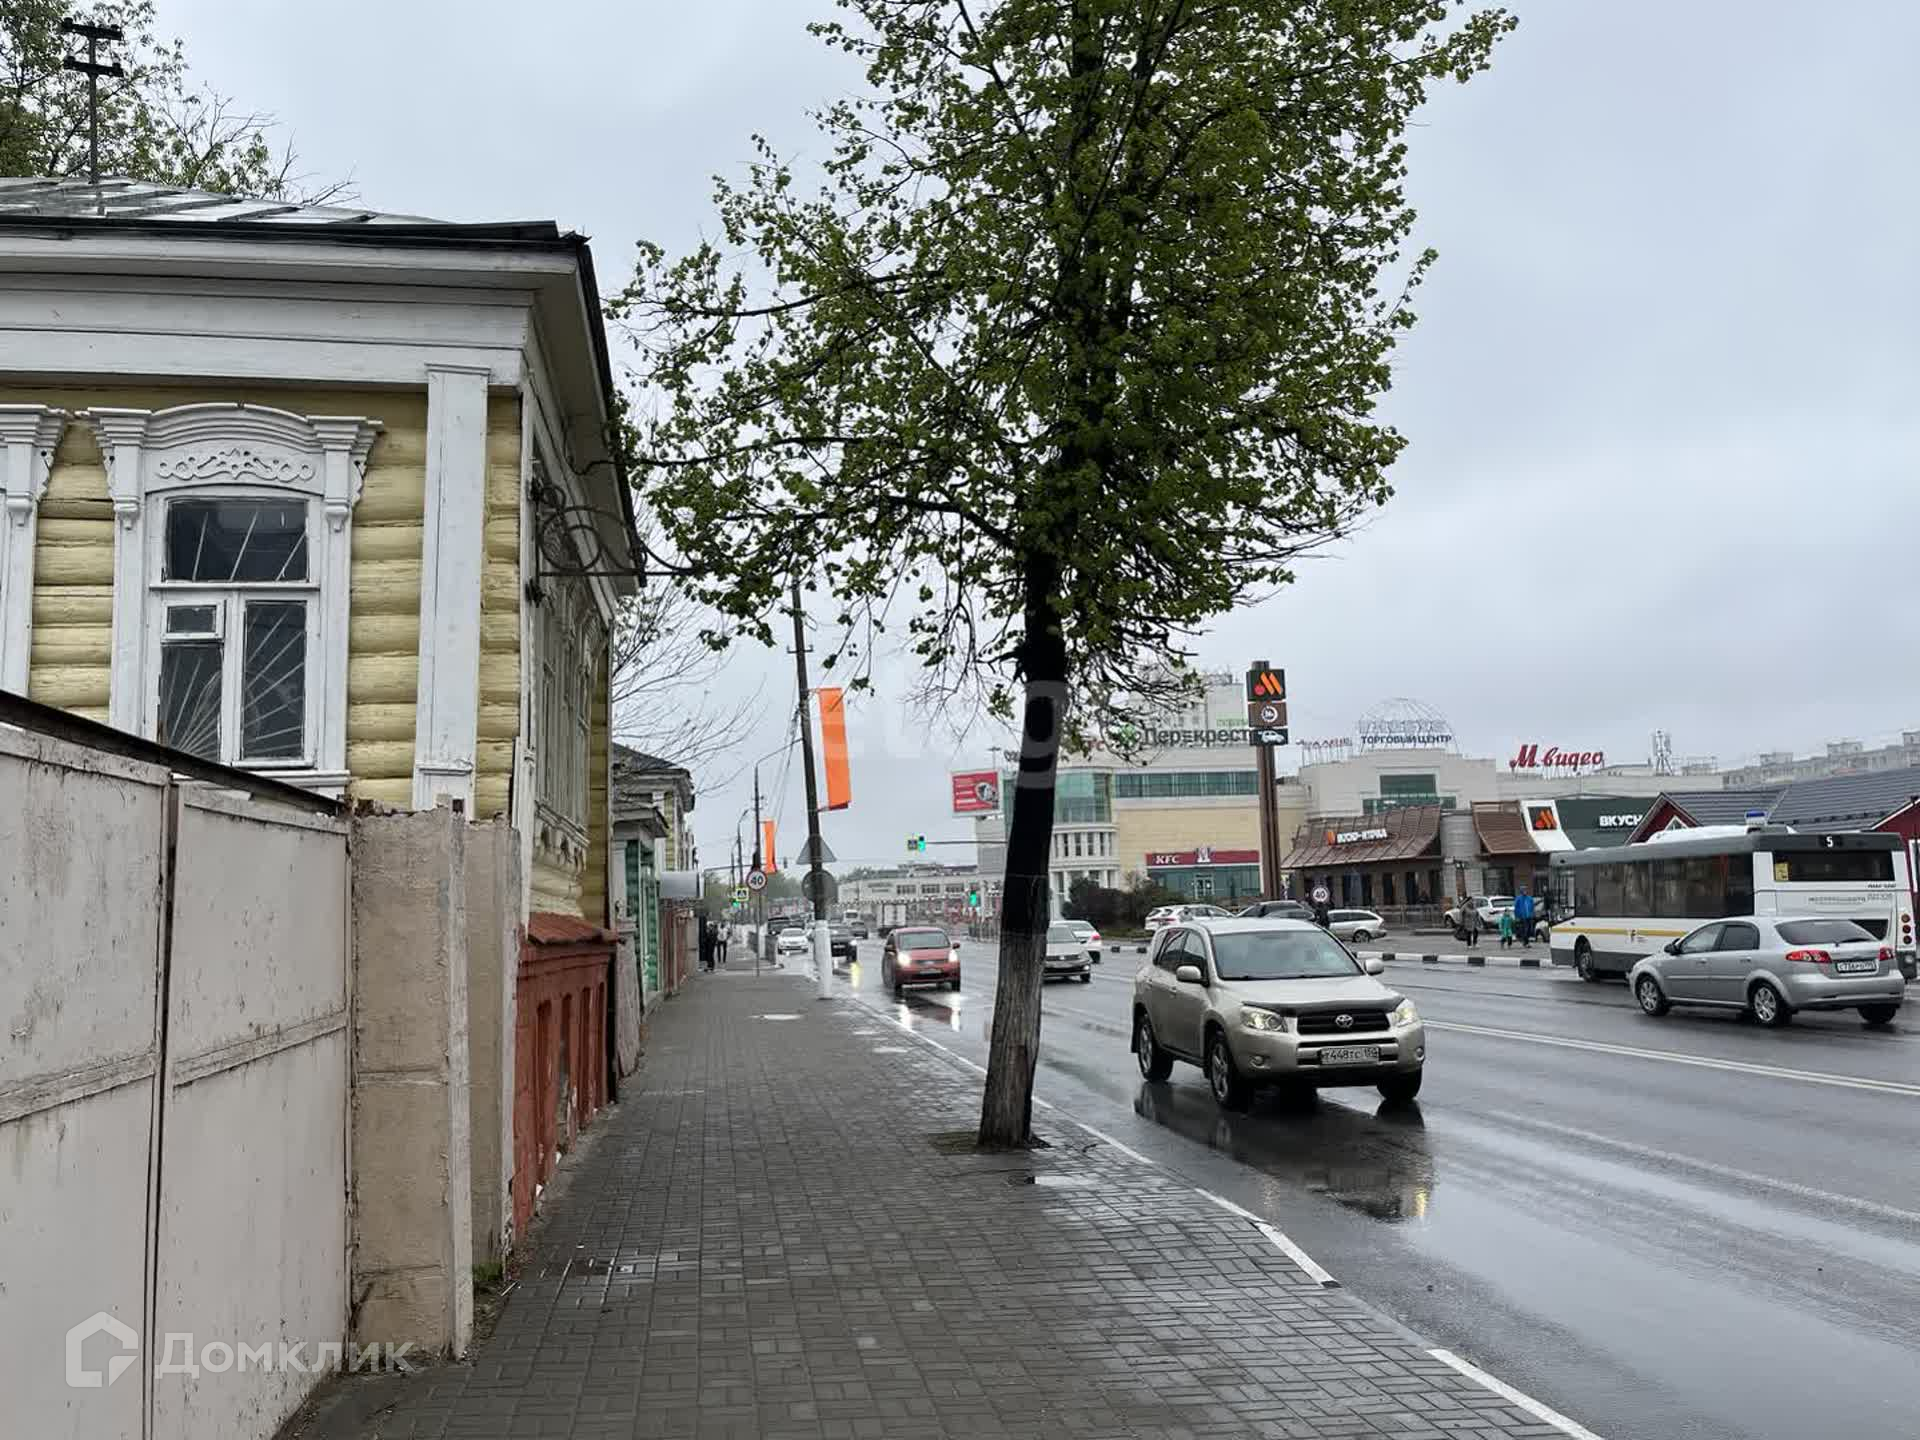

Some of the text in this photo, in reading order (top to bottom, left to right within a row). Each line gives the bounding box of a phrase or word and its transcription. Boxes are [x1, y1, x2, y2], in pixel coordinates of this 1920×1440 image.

[1360, 734, 1416, 746] ТОРГОВЫЙ
[1417, 734, 1452, 746] ЦЕНТР
[1826, 836, 1834, 848] 5
[1155, 855, 1180, 865] KFC
[751, 875, 764, 886] 40
[1315, 890, 1326, 898] 40
